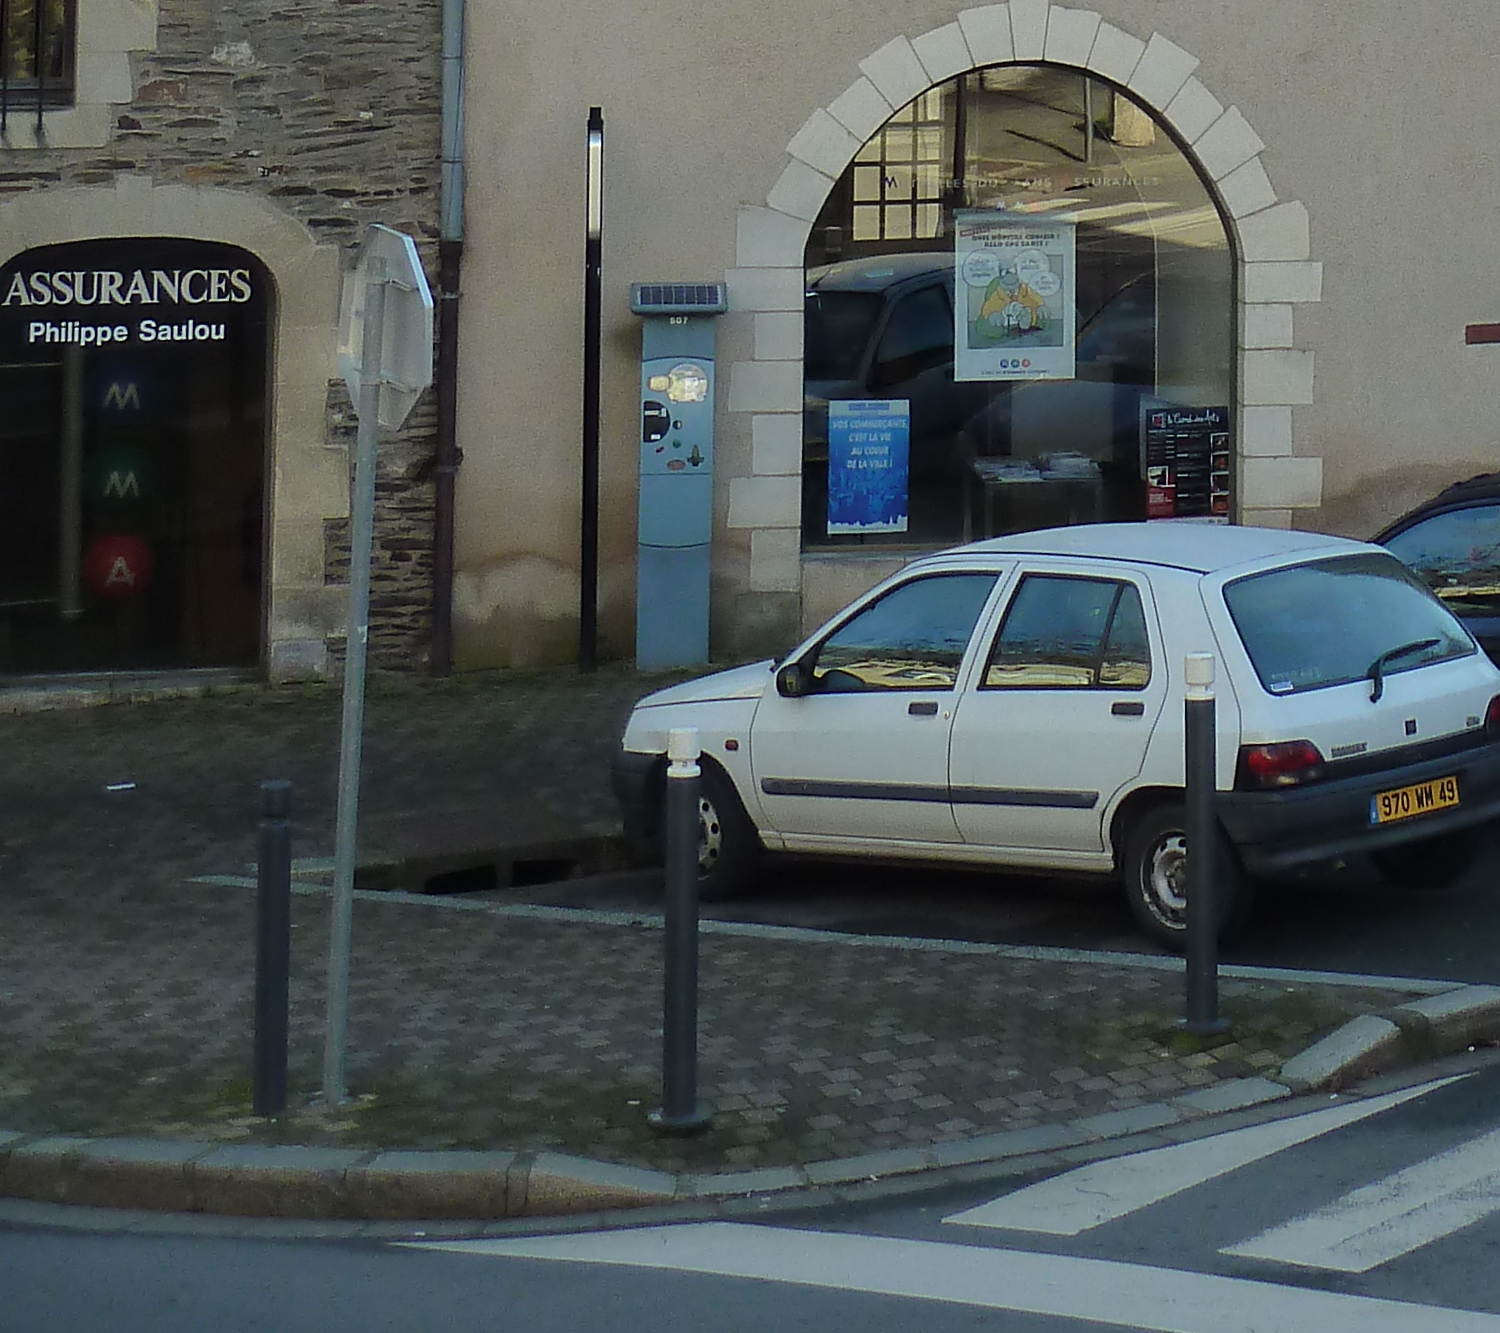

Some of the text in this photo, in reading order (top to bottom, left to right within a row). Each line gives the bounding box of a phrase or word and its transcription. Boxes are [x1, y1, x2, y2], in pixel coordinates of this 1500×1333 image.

[2, 269, 251, 306] ASSURANCES
[29, 320, 225, 346] Philippe Saulou
[1382, 779, 1455, 817] 970 WM 49
